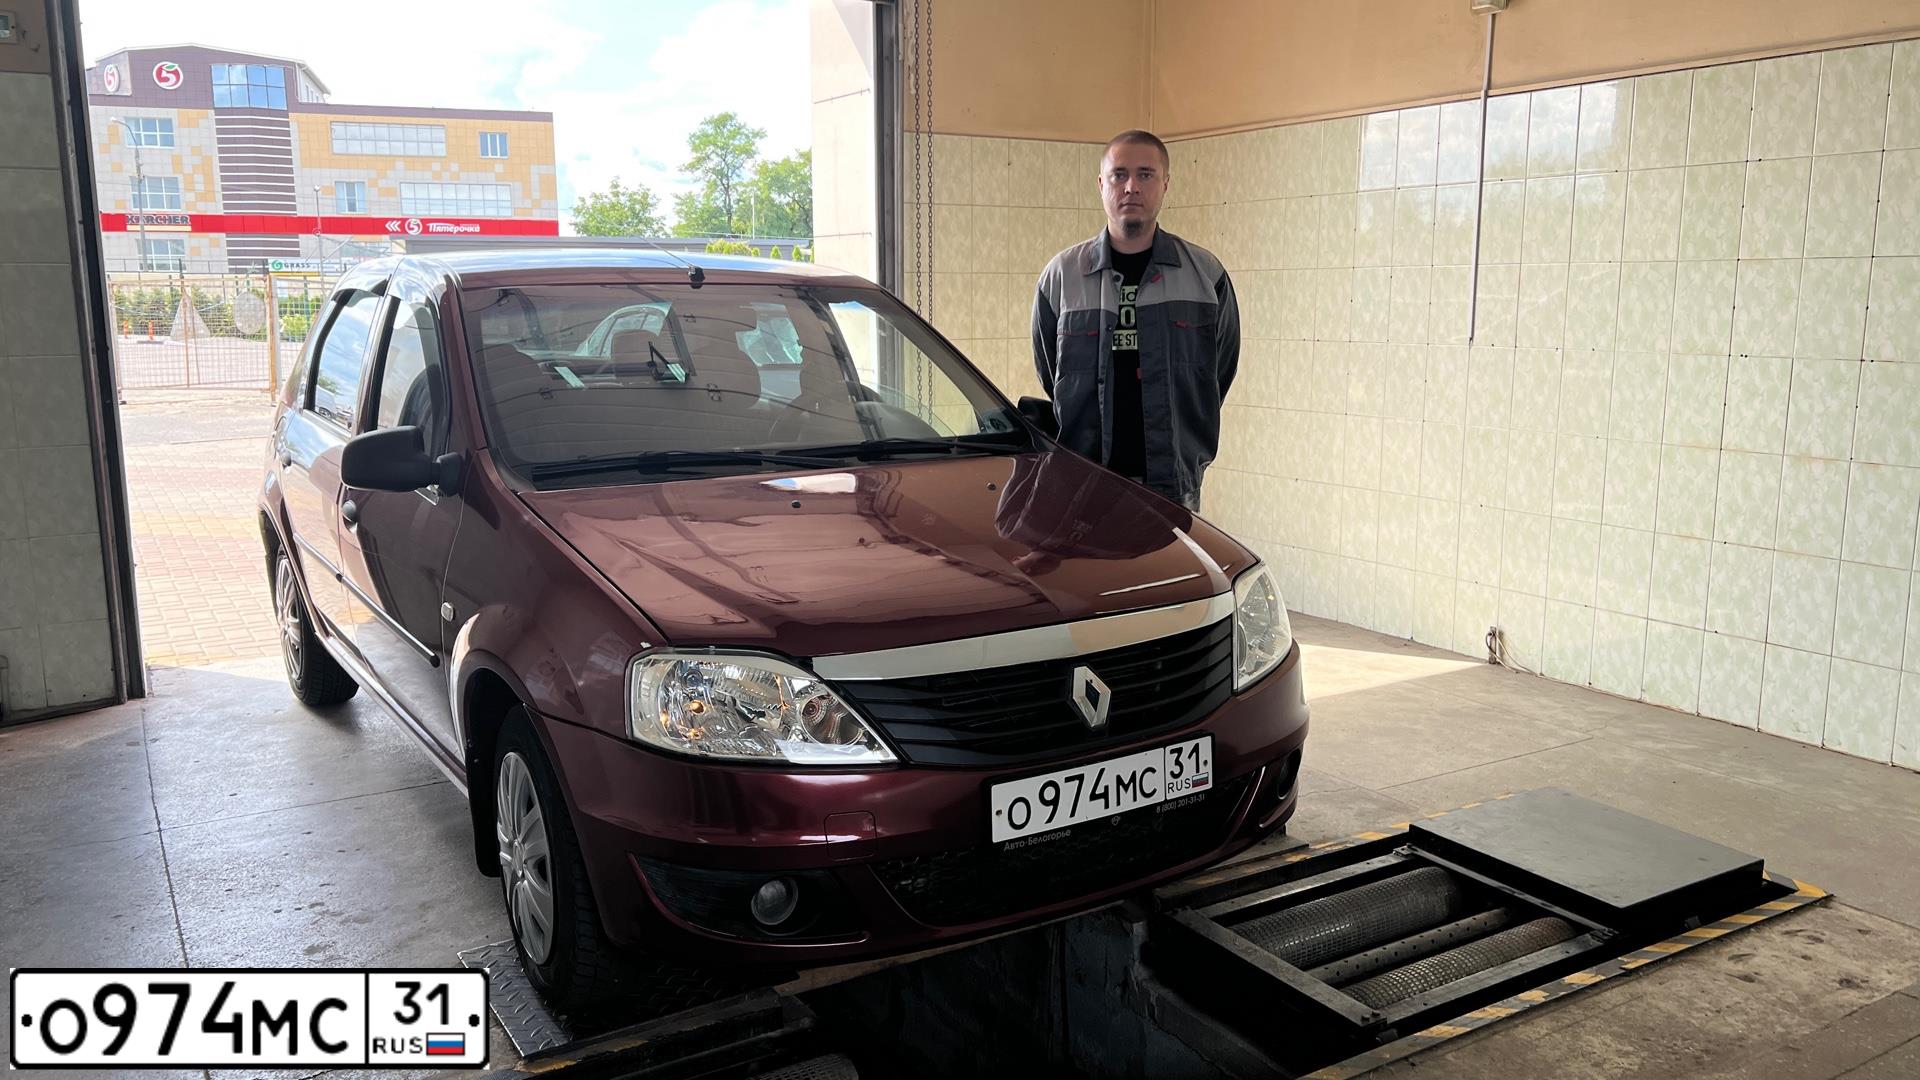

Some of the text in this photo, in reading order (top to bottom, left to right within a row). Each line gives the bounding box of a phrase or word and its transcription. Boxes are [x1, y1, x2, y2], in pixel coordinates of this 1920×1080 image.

[1169, 743, 1200, 780] 31
[1007, 766, 1158, 831] О974МС
[1167, 777, 1192, 794] RUS
